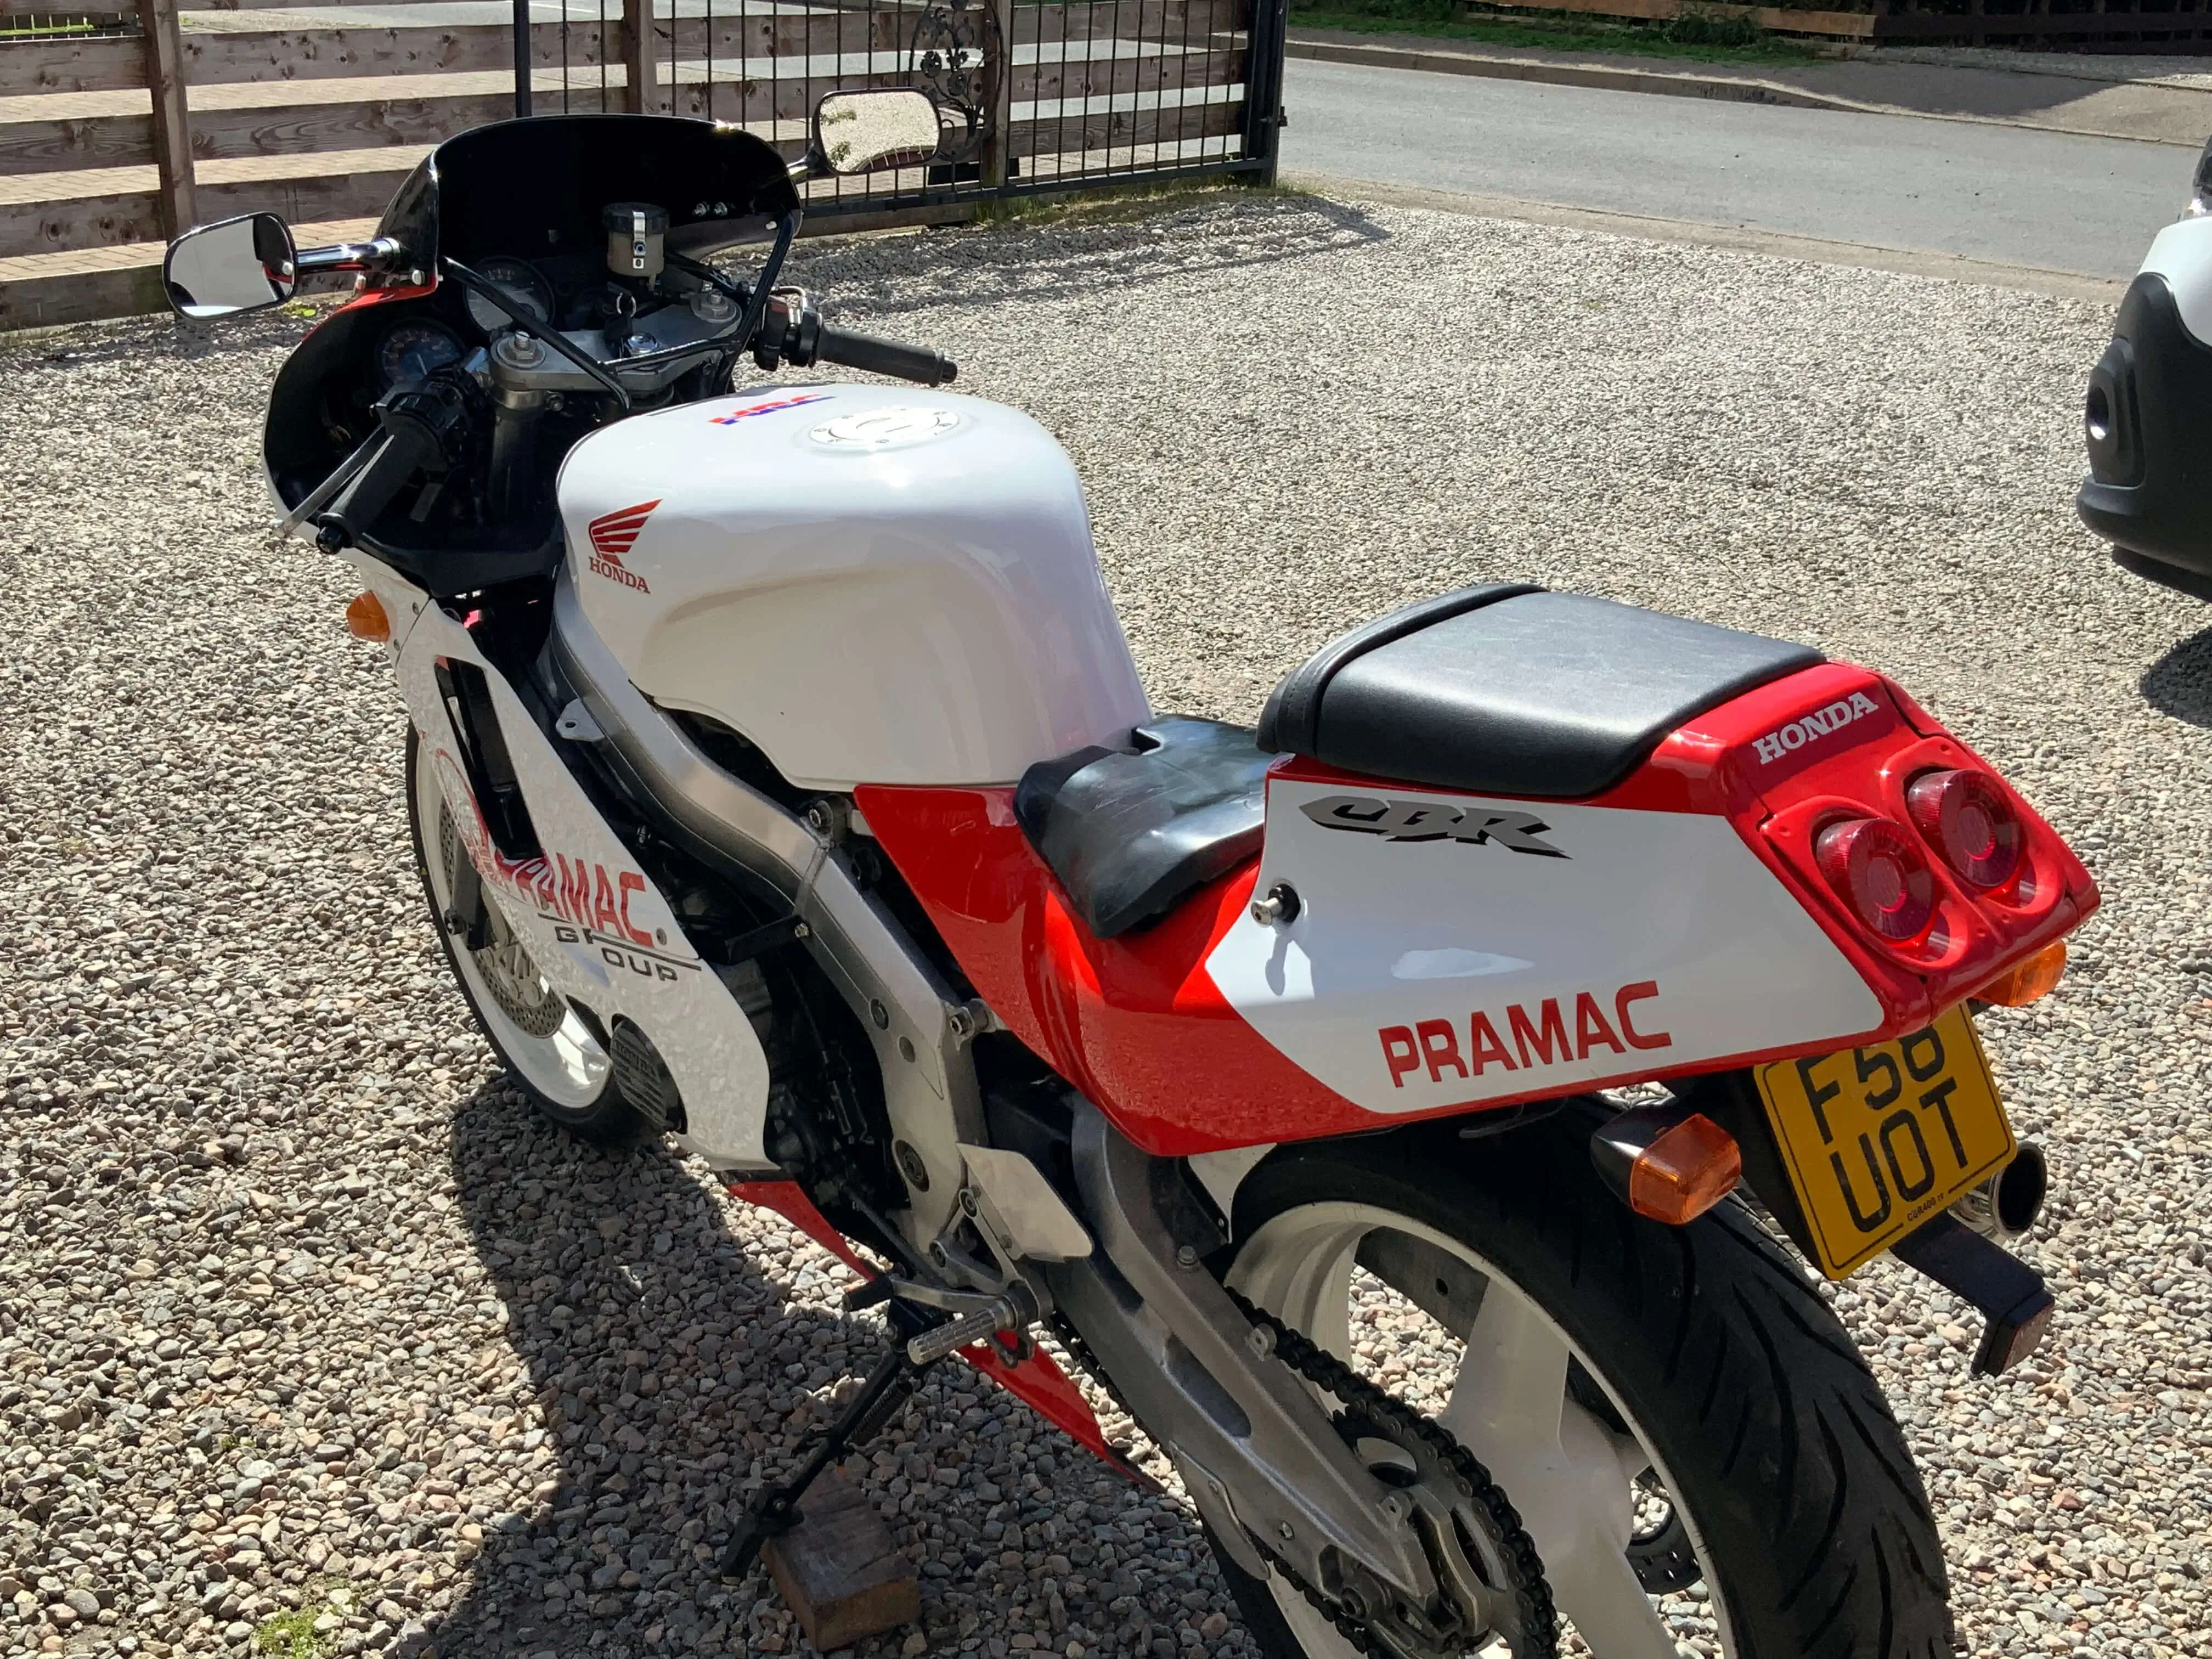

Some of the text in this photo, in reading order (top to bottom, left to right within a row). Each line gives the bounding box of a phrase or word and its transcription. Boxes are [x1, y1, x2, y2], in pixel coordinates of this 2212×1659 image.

[589, 556, 651, 594] HONDA
[1752, 692, 1879, 765] HONDA
[1299, 795, 1573, 859] CBR
[1379, 980, 1673, 1088] PRAMAC
[1830, 1077, 1968, 1233] UOT
